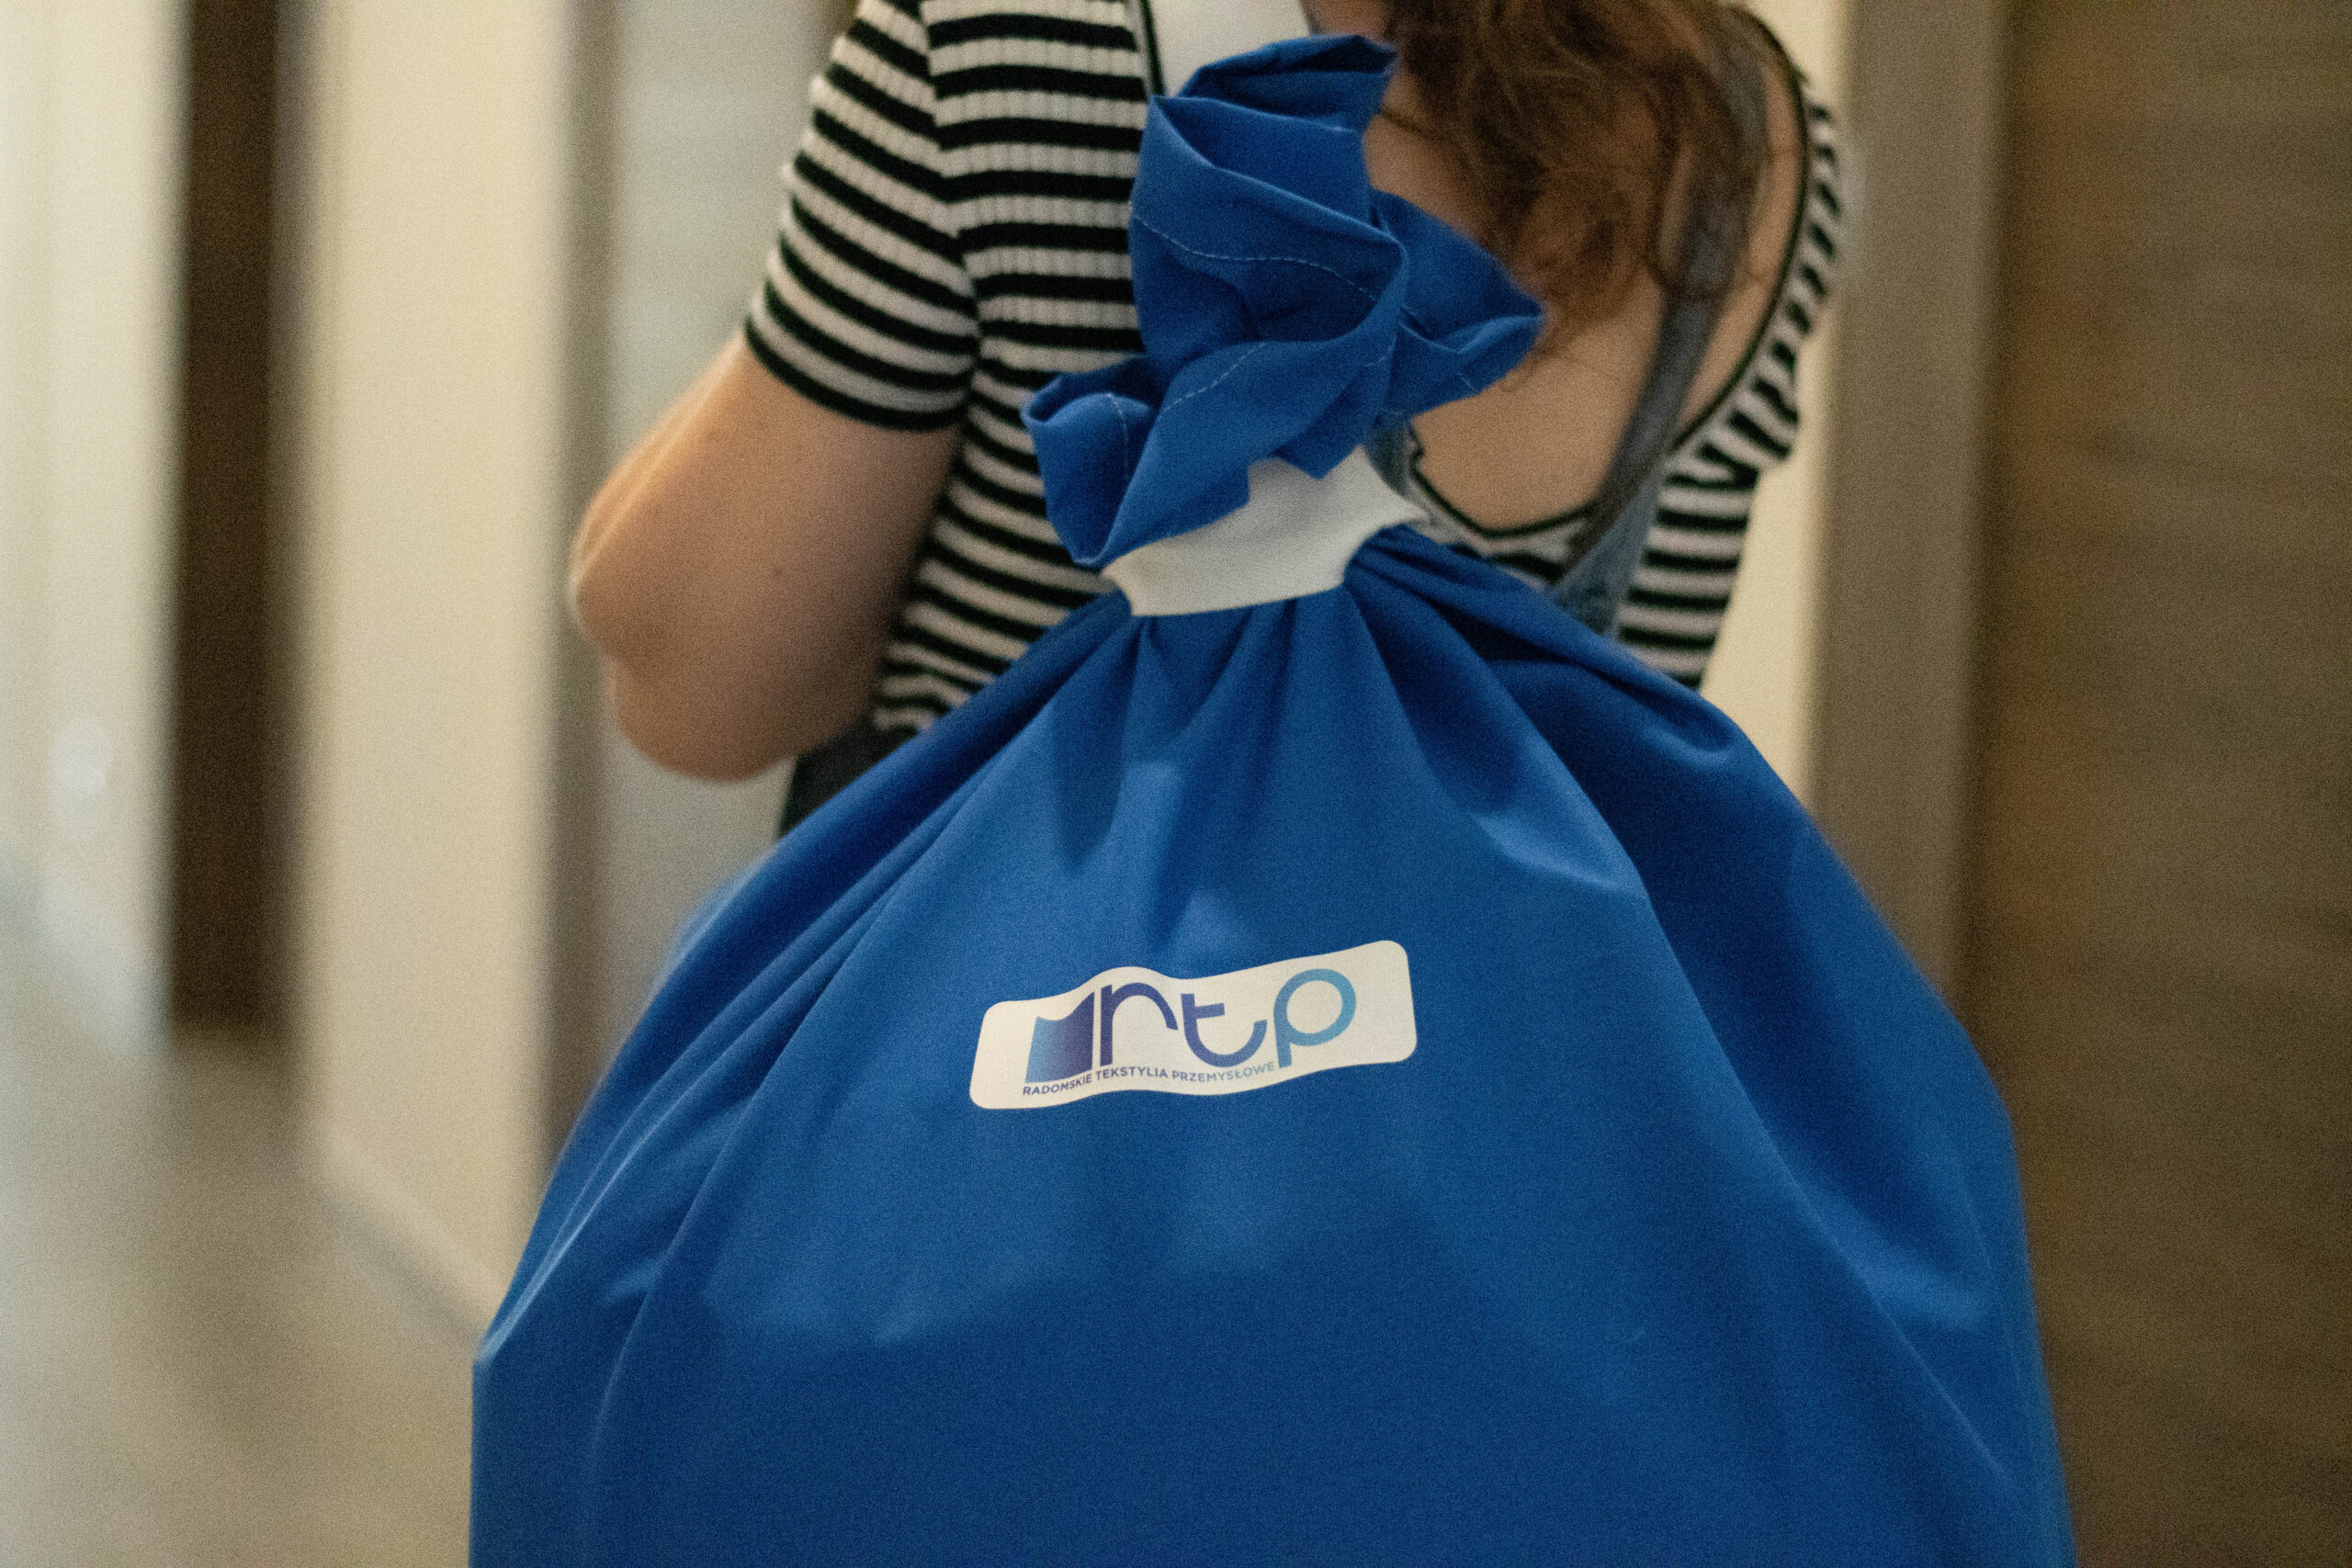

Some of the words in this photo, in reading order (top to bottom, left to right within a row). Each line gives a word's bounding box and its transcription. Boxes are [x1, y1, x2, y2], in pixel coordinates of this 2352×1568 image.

[1099, 967, 1356, 1068] rtp
[1022, 1073, 1092, 1096] RADOMSKIE
[1095, 1066, 1168, 1081] TEKSTYLIA
[1172, 1061, 1275, 1083] PRZEMYSŁOWE
